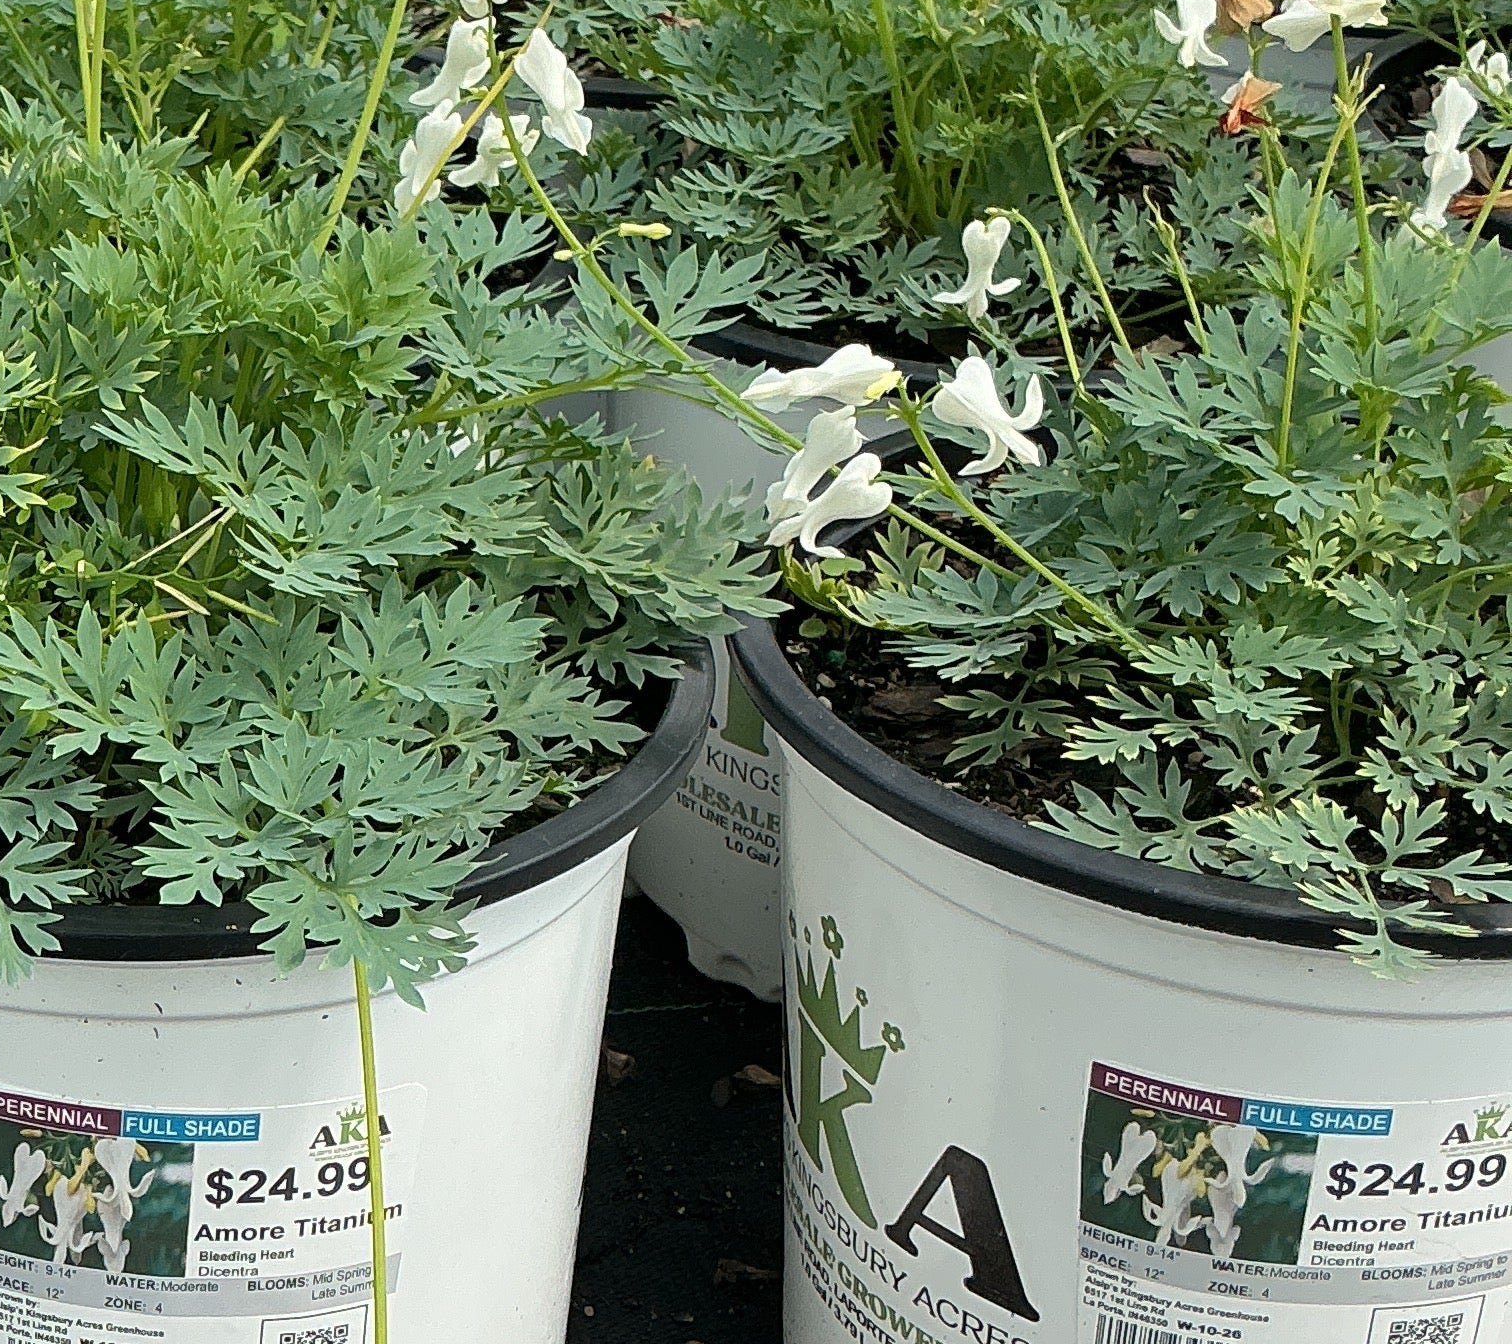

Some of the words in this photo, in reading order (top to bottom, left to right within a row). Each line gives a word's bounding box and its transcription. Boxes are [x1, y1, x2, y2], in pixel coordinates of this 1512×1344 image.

[706, 744, 780, 796] KINGS
[680, 775, 780, 834] LESALE
[1104, 1072, 1227, 1117] PERENNIAL
[1246, 1105, 1303, 1126] FULL
[1310, 1112, 1388, 1130] SHADE
[126, 1117, 177, 1136] FULL
[184, 1120, 256, 1136] SHADE
[797, 1006, 1040, 1321] KA
[1325, 1154, 1507, 1200] $24.99
[205, 1156, 370, 1209] $24.99
[791, 1140, 907, 1292] KINGSBURY
[1309, 1214, 1407, 1232] Amore
[1417, 1203, 1512, 1230] Titaniu
[194, 1224, 285, 1242] Amore
[1313, 1241, 1374, 1253] Bleeding
[1378, 1240, 1415, 1251] Heart
[199, 1251, 257, 1263] Bleeding
[260, 1248, 295, 1260] Heart
[1083, 1225, 1138, 1252] HEIGHT:
[1211, 1259, 1269, 1277] WATER:
[1269, 1268, 1331, 1281] Moderate
[1362, 1268, 1427, 1281] BLOOMS:
[1431, 1266, 1453, 1277] Mid
[1456, 1259, 1493, 1273] Spring
[1496, 1255, 1508, 1265] to
[1311, 1255, 1375, 1266] Dicentra
[46, 1265, 77, 1279] 9-14"
[106, 1274, 159, 1291] WATER:
[161, 1280, 218, 1292] Moderate
[247, 1277, 309, 1291] BLOOMS:
[313, 1273, 333, 1285] Mid
[336, 1266, 372, 1282] Spring
[198, 1266, 259, 1277] Dicentra
[1081, 1247, 1131, 1272] SPACE:
[1207, 1281, 1252, 1297] ZONE:
[1261, 1288, 1269, 1298] 4
[1428, 1276, 1454, 1290] Late
[1457, 1268, 1507, 1287] Summer
[46, 1288, 64, 1299] 12"
[104, 1297, 146, 1312] ZONE:
[155, 1303, 163, 1314] 4
[311, 1288, 336, 1300] Late
[339, 1280, 374, 1296] Summ
[1083, 1296, 1095, 1306] La
[1177, 1320, 1242, 1339] W-10-26
[1121, 1288, 1172, 1307] Kingsbury
[1175, 1301, 1204, 1313] Acres
[1207, 1307, 1269, 1323] Greenhouse
[1151, 1306, 1165, 1316] Rd
[17, 1318, 31, 1328] 1st
[33, 1321, 52, 1332] Line
[54, 1327, 67, 1335] Rd
[26, 1309, 73, 1327] Kingsbury
[76, 1319, 103, 1331] Acres
[106, 1323, 165, 1338] Greenhouse
